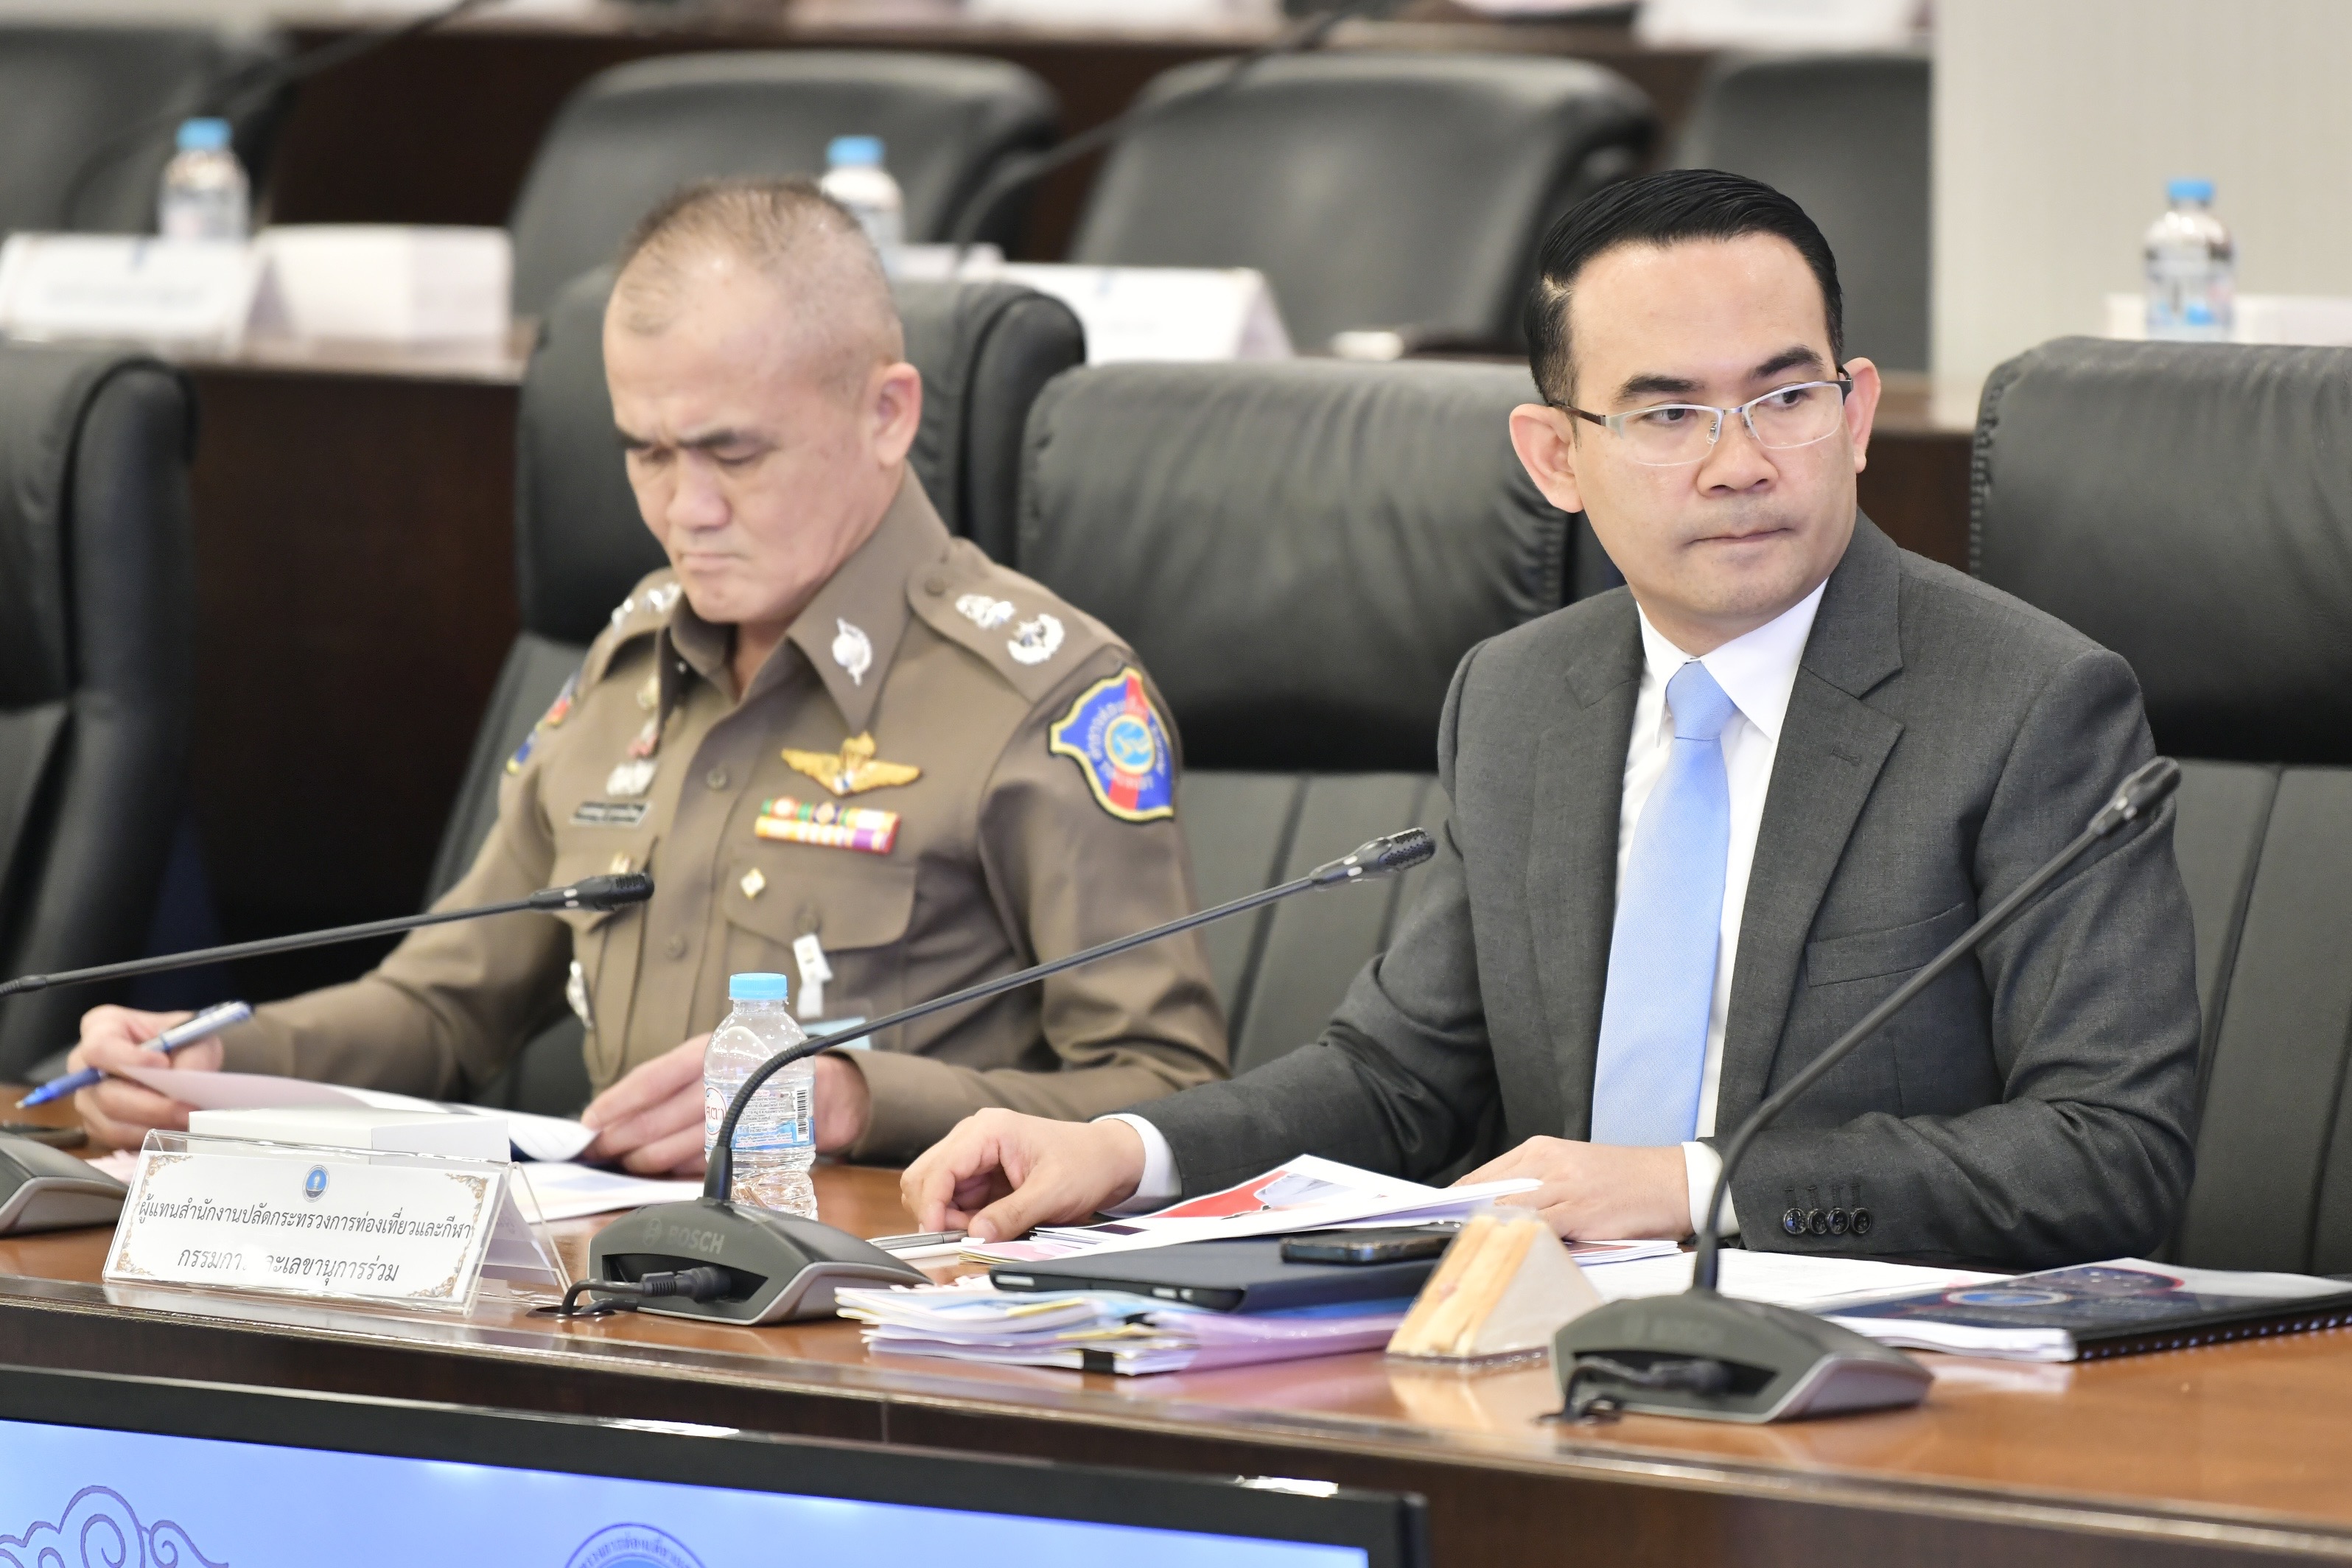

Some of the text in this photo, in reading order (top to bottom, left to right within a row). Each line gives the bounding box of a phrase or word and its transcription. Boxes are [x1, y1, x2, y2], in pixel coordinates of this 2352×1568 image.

[138, 1193, 472, 1239] ผู้แทนสำนักงานปลัดกระทรวงการท่องเที่ยวและกีฬา
[667, 1225, 726, 1255] BOSCH
